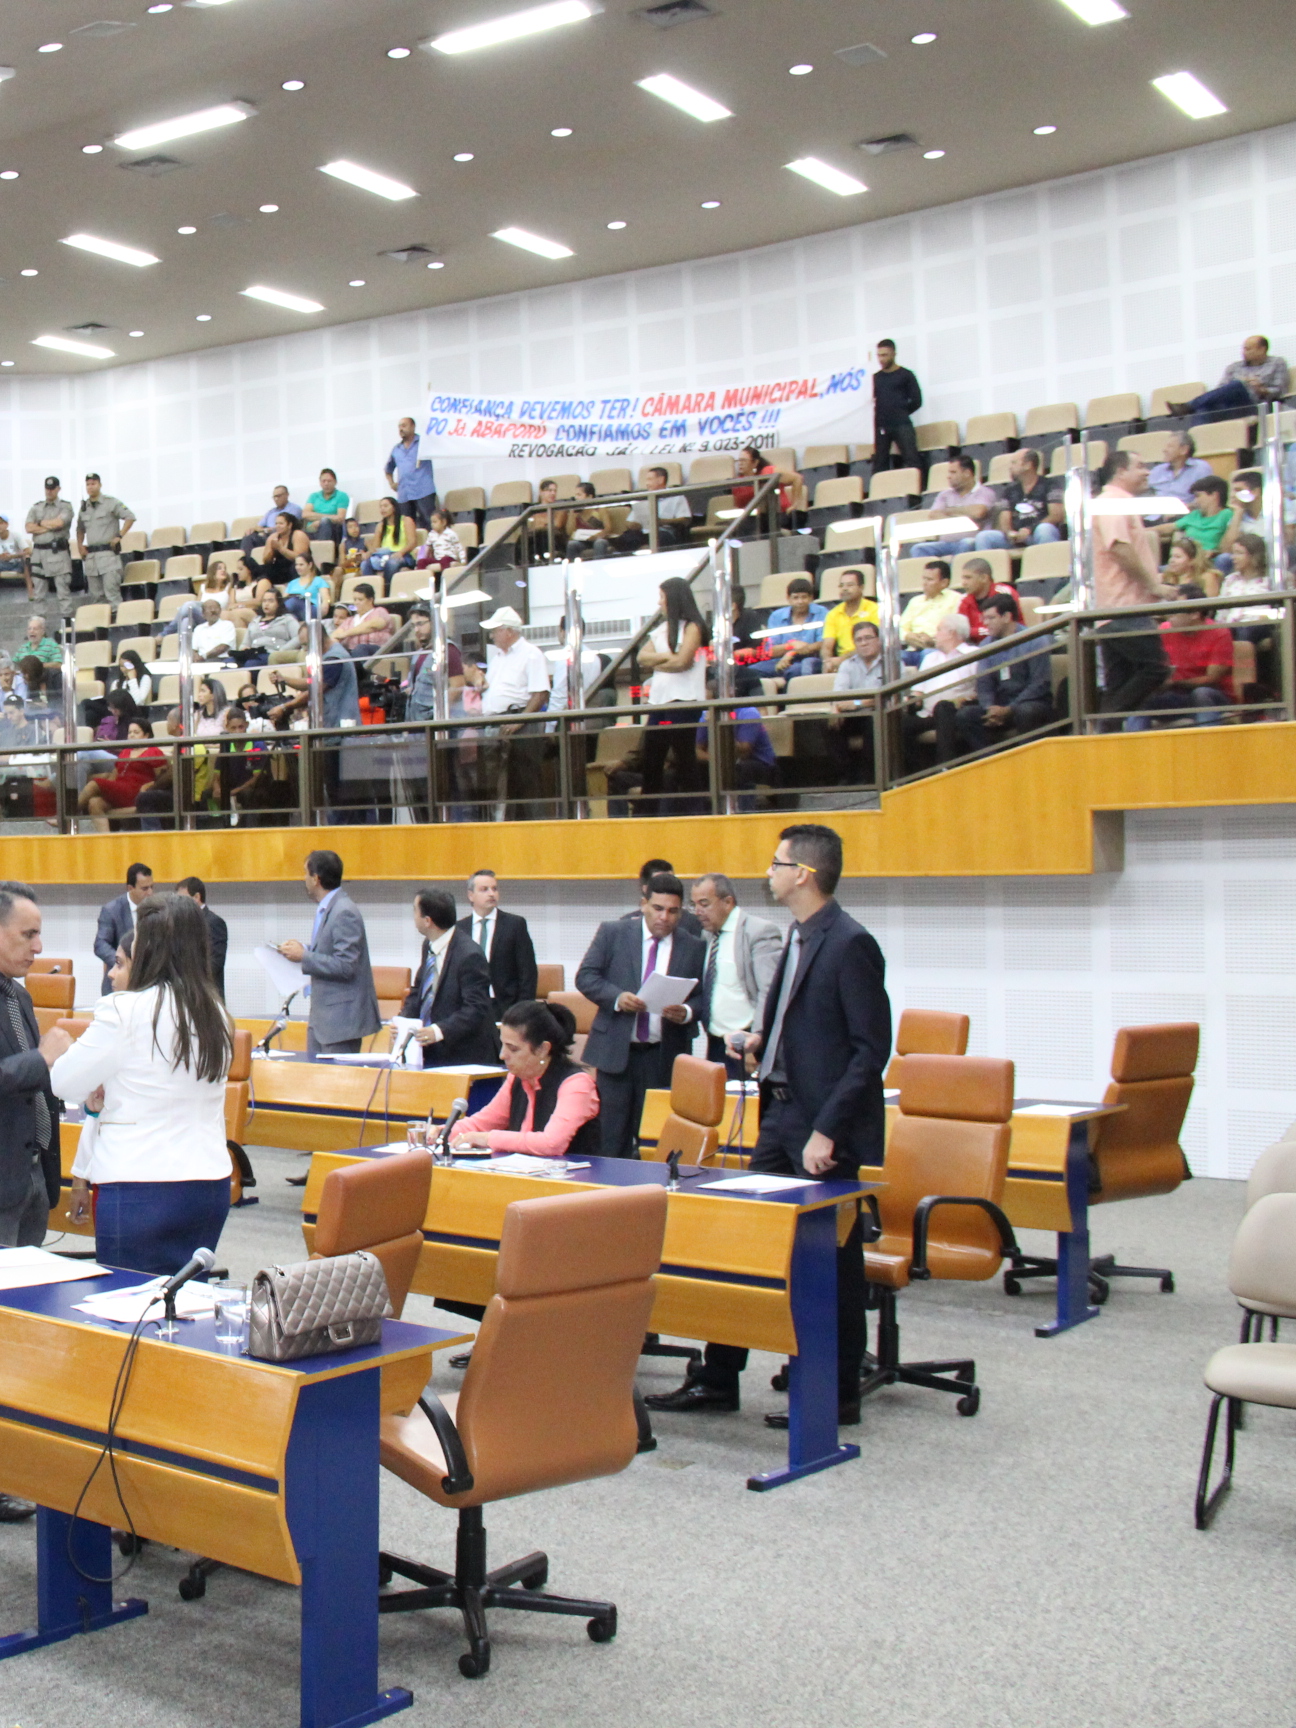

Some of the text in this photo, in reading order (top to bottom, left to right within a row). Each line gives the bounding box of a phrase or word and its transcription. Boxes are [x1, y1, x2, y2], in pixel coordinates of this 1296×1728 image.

[430, 396, 514, 421] CONFIANÇA
[518, 400, 595, 420] DEVEMOS
[599, 398, 640, 419] TER!
[641, 392, 716, 417] CÂMARA
[426, 417, 448, 436] DO
[554, 422, 652, 442] CONFIAMOS
[659, 419, 687, 440] EM
